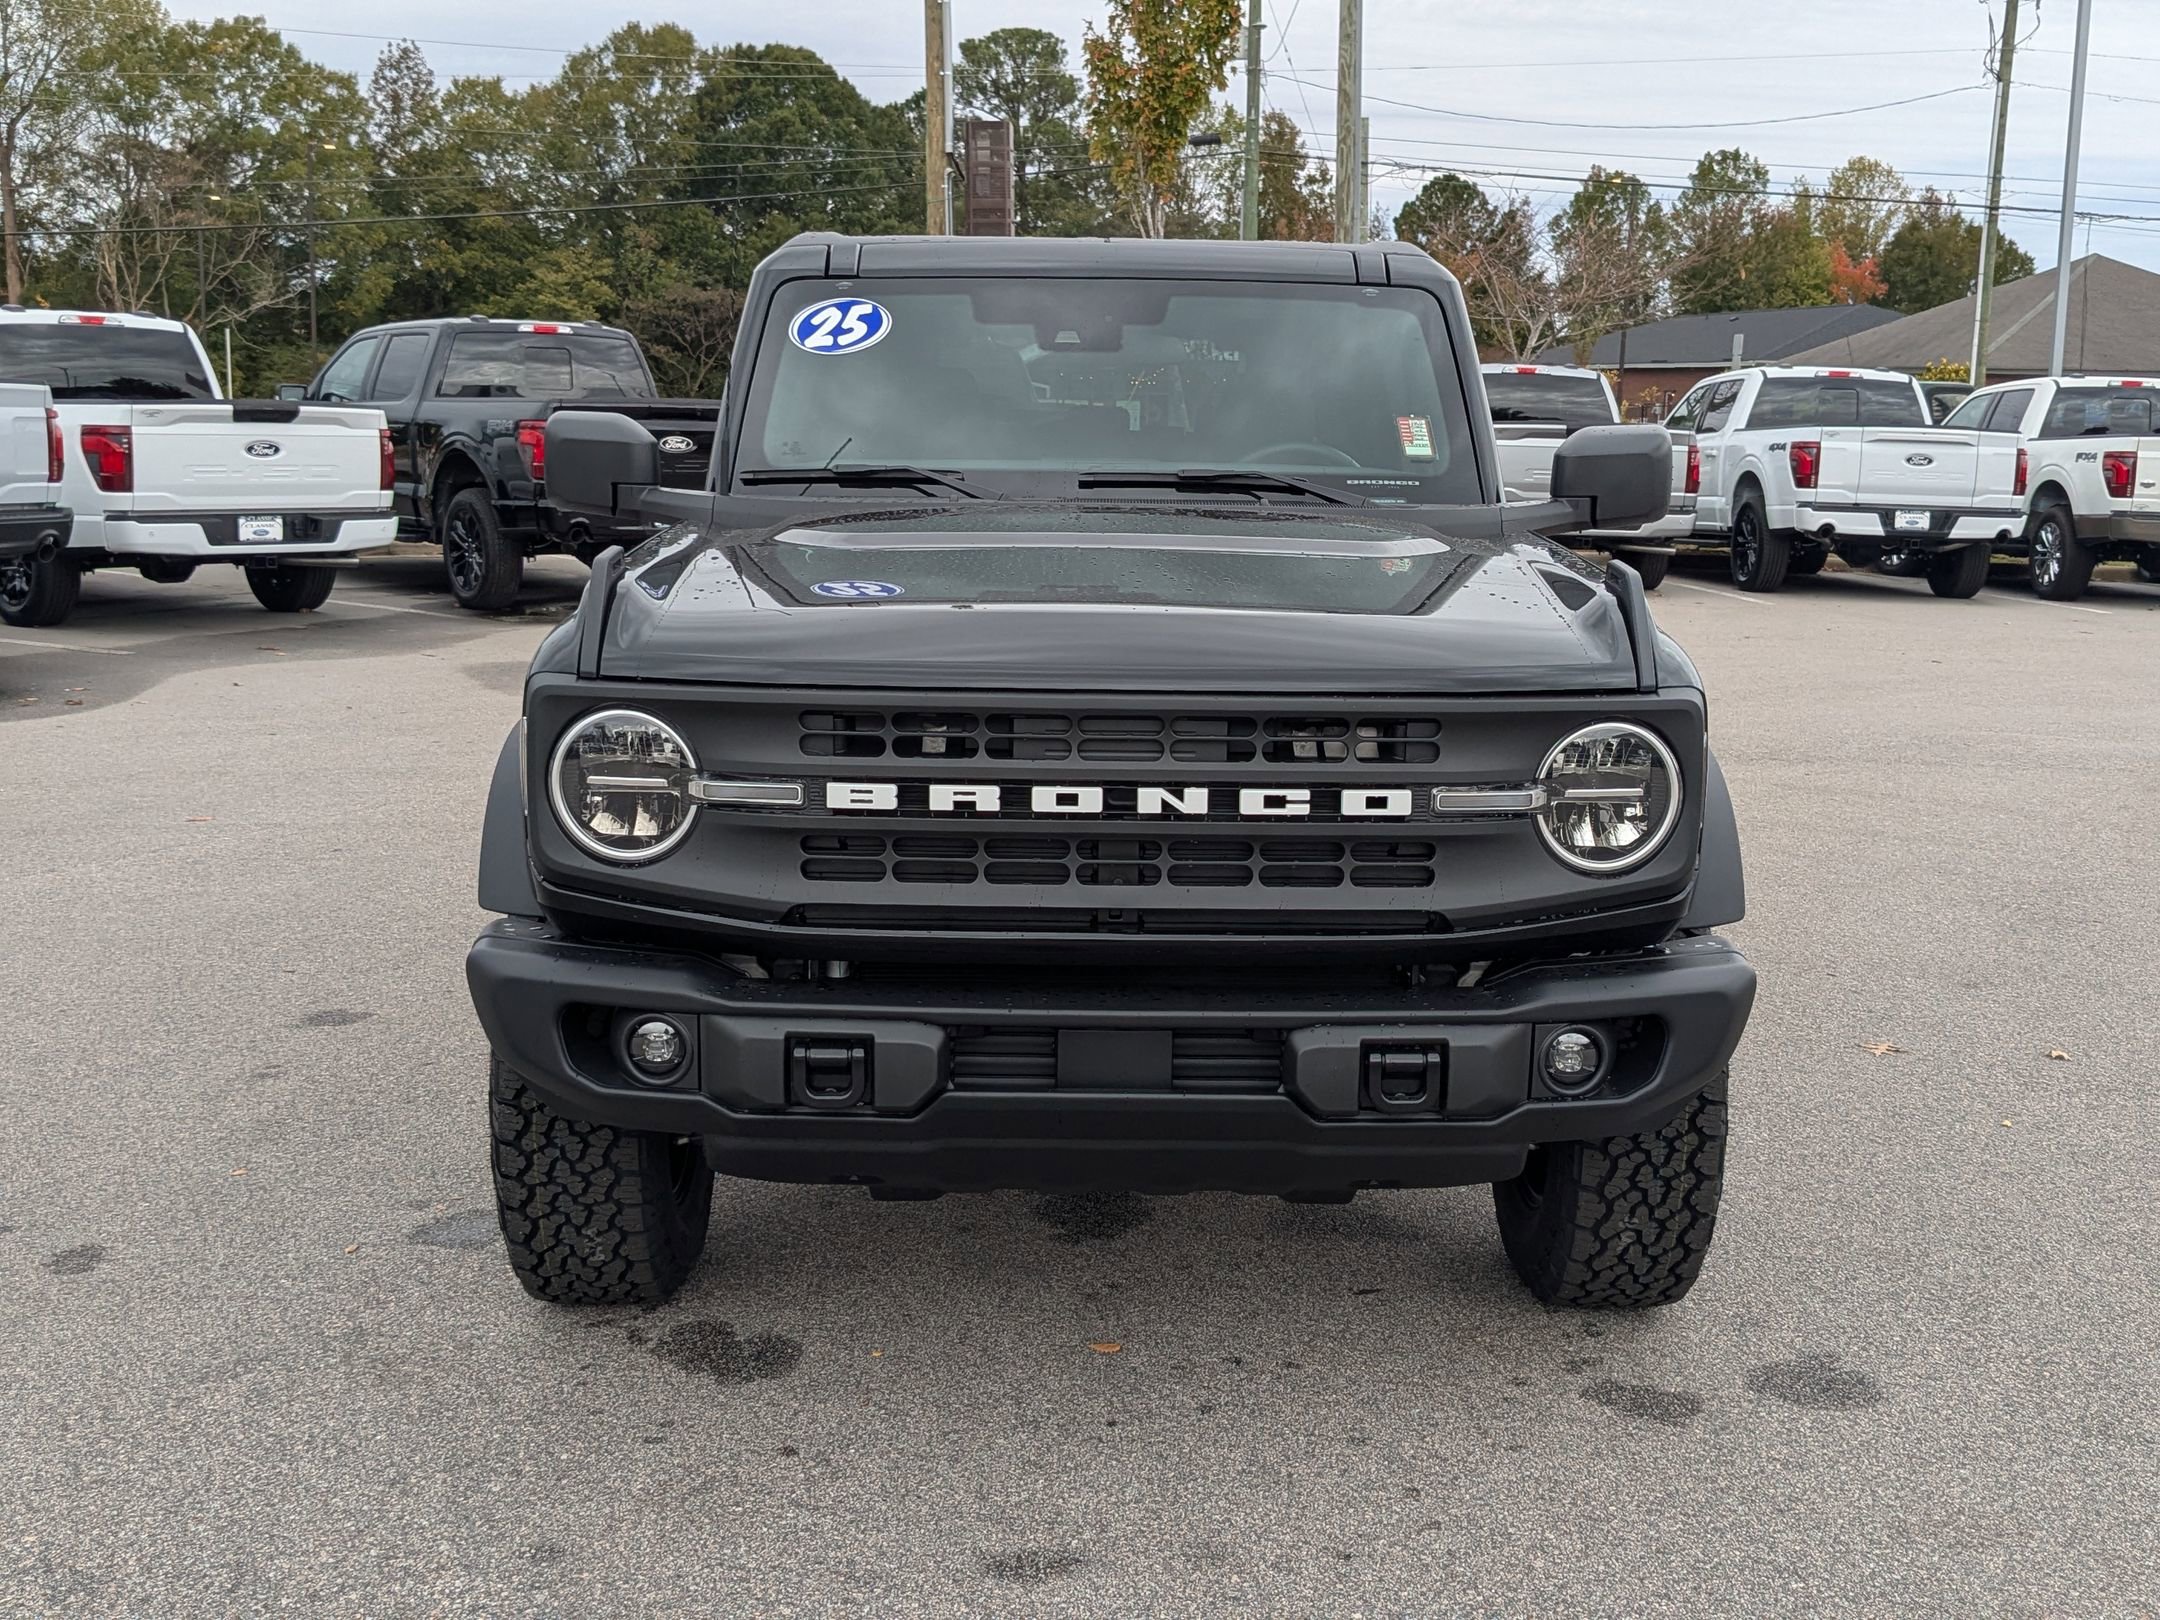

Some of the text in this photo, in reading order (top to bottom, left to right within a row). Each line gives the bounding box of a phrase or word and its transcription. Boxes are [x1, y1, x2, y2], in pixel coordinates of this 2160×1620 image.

[803, 303, 873, 348] 25
[250, 442, 277, 456] Ford
[664, 438, 689, 450] Ford
[1908, 456, 1931, 466] Ford
[2075, 452, 2098, 463] FX4
[825, 781, 1412, 816] BRONCO
